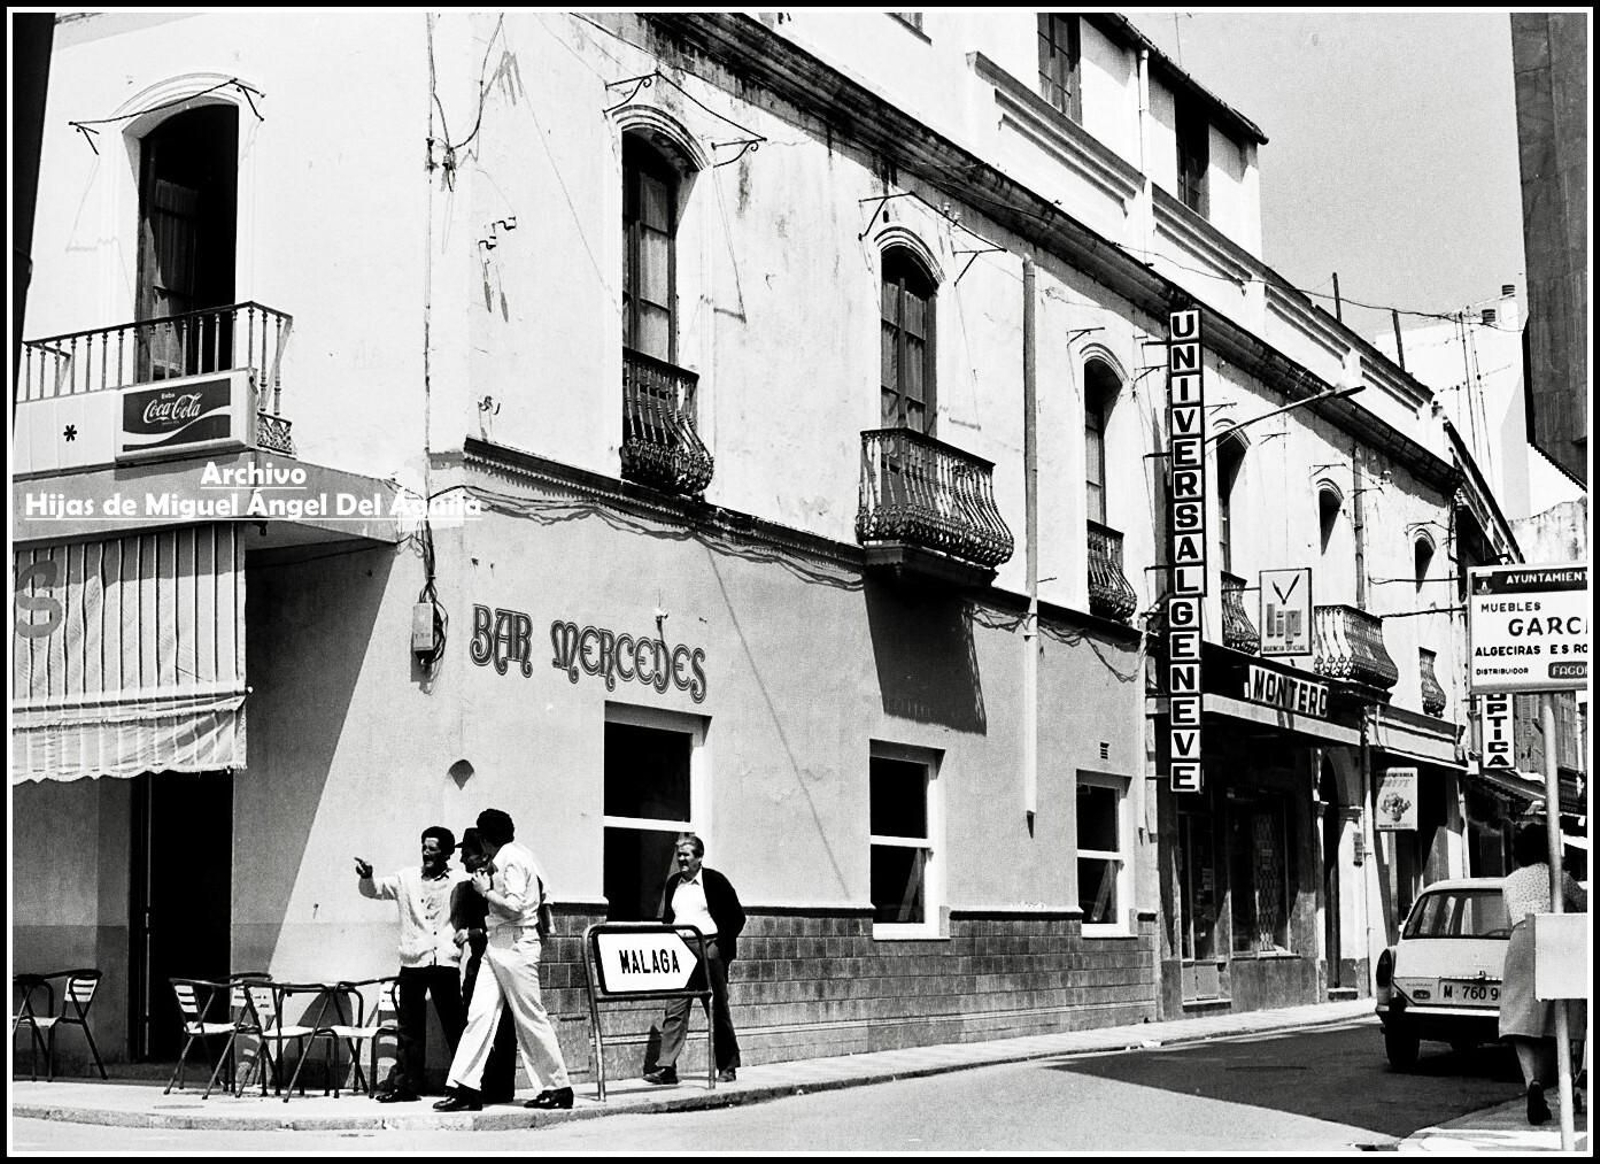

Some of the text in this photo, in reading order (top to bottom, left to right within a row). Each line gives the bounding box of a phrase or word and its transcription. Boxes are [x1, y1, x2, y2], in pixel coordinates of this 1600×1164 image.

[143, 393, 202, 424] Coca-Cola
[1170, 313, 1199, 790] UNIVERSAL GENEVE
[1481, 601, 1541, 613] MUEBLES
[1508, 616, 1588, 637] GARC
[469, 603, 707, 704] BAR MERCEDES
[1475, 645, 1541, 656] ALGECIRAS
[1476, 667, 1529, 676] DISTRIBUIDOR
[1253, 668, 1329, 717] MONTERO
[618, 948, 681, 974] MALAGA
